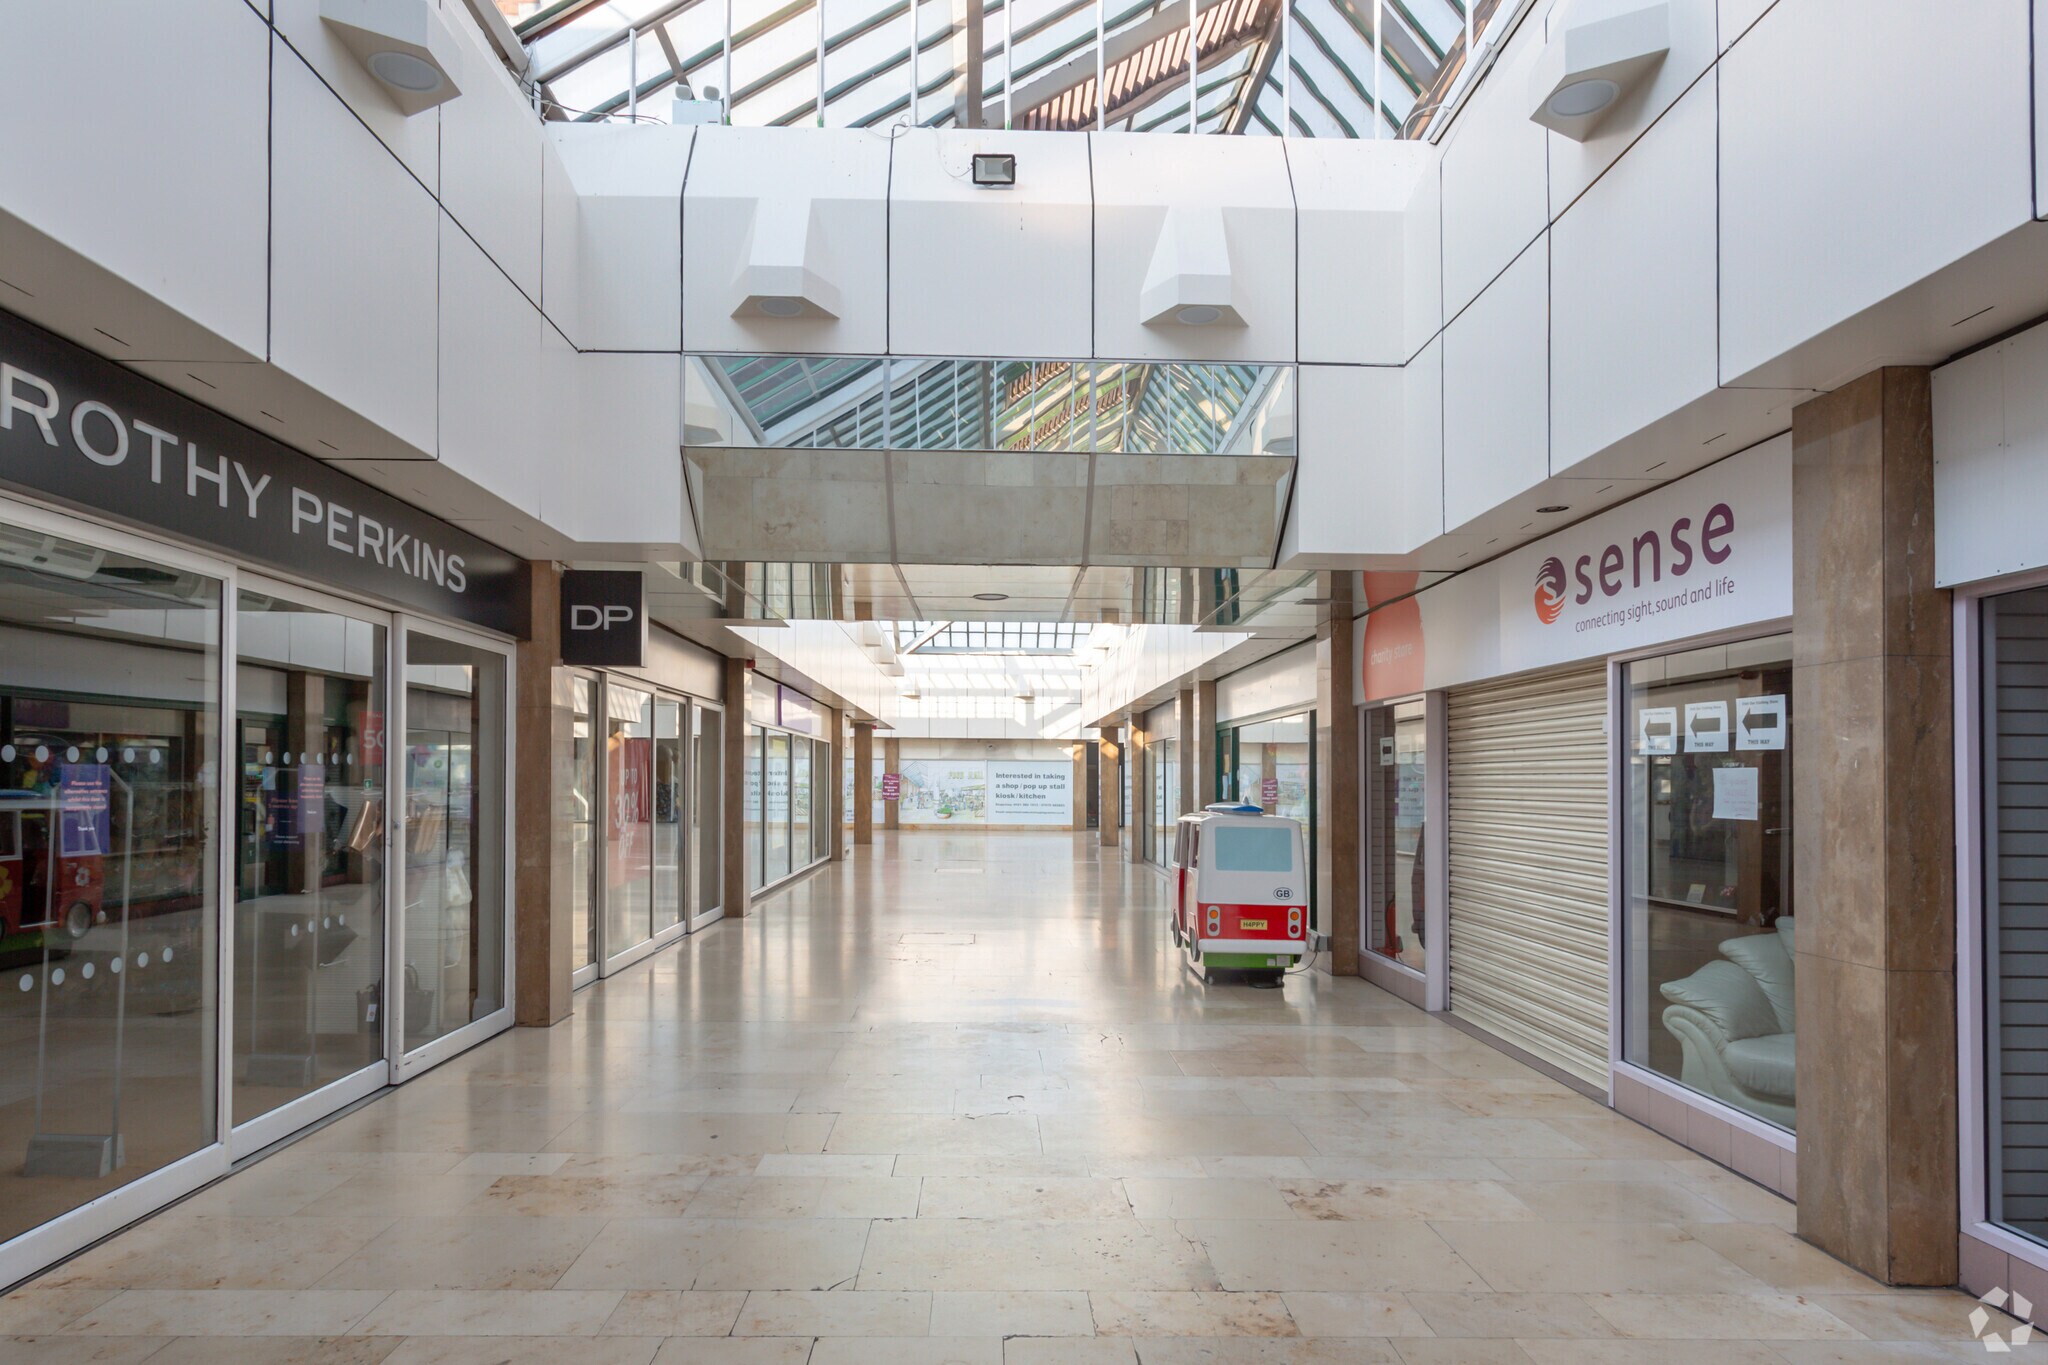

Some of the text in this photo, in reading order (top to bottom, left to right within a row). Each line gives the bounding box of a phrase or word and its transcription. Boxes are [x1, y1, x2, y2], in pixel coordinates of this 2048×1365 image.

[0, 362, 467, 593] ROTHY PERKINS
[1575, 503, 1735, 605] sense
[571, 605, 633, 630] DP
[1576, 576, 1735, 632] connecting sight, sound and life
[1370, 643, 1412, 666] charity store
[631, 768, 638, 784] TO
[615, 792, 639, 829] 30%
[619, 830, 634, 860] OFF
